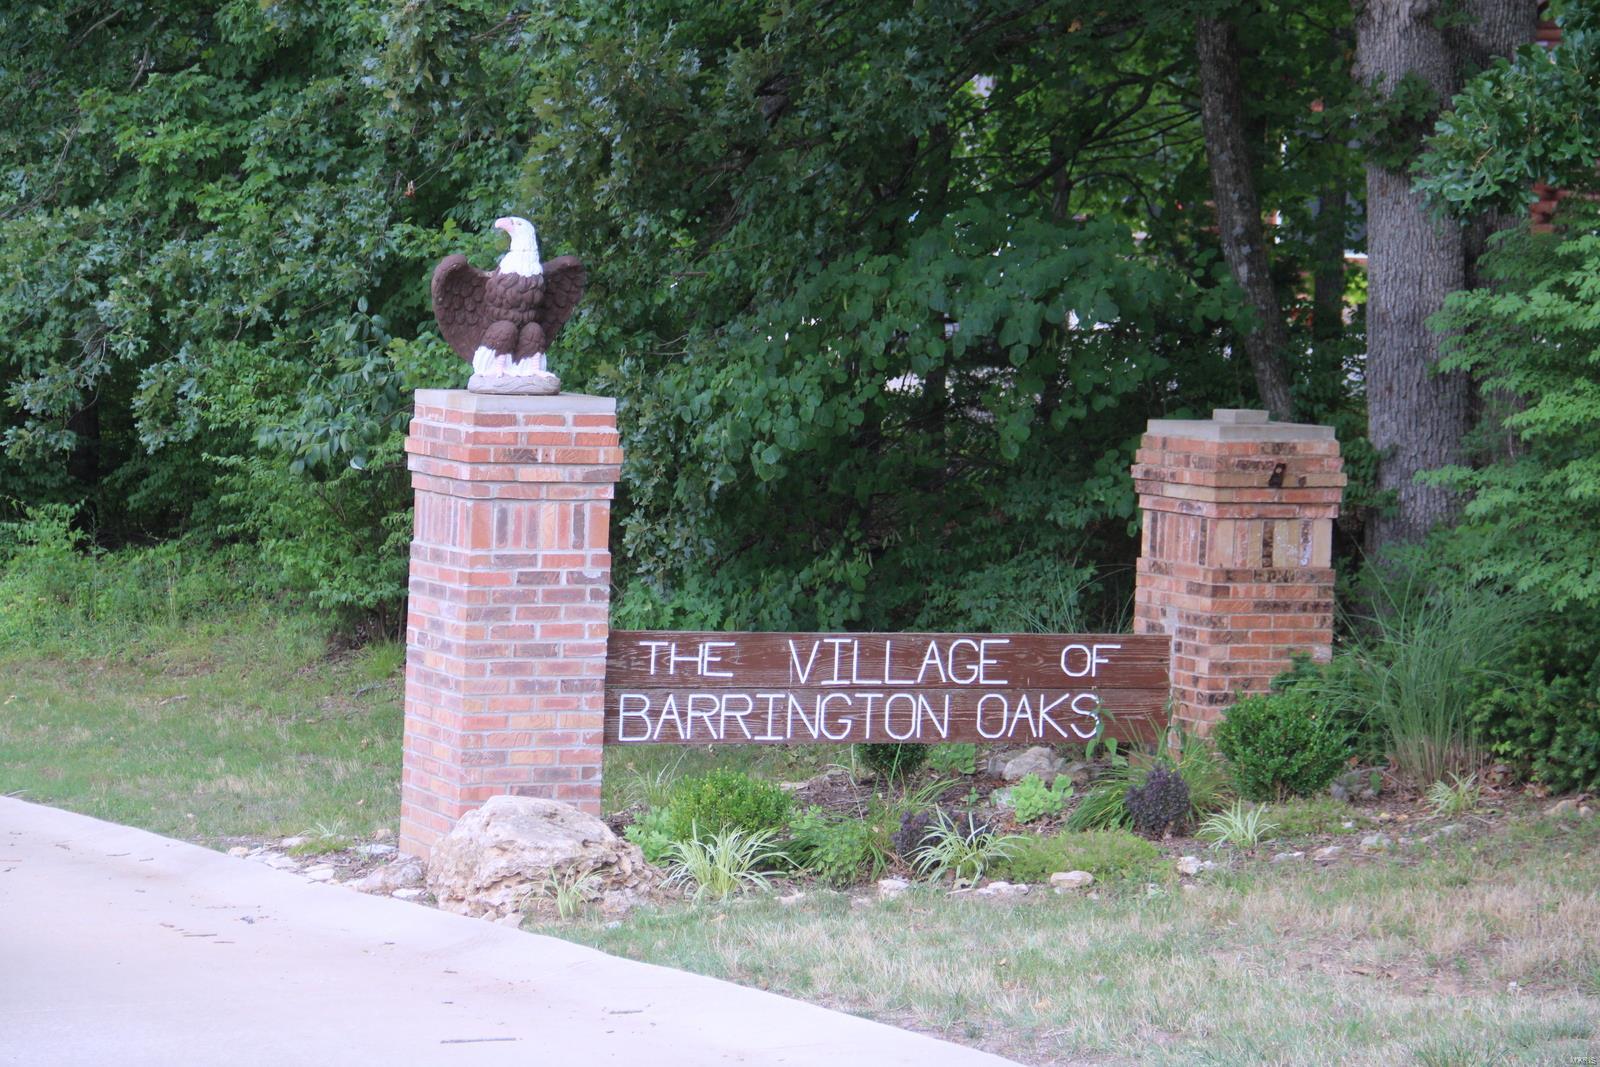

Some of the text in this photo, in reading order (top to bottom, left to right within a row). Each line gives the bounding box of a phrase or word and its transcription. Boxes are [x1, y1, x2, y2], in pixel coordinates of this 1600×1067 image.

[639, 638, 1121, 685] THE VILLAGE OF
[618, 692, 1100, 742] BARRINGTON OAKS
